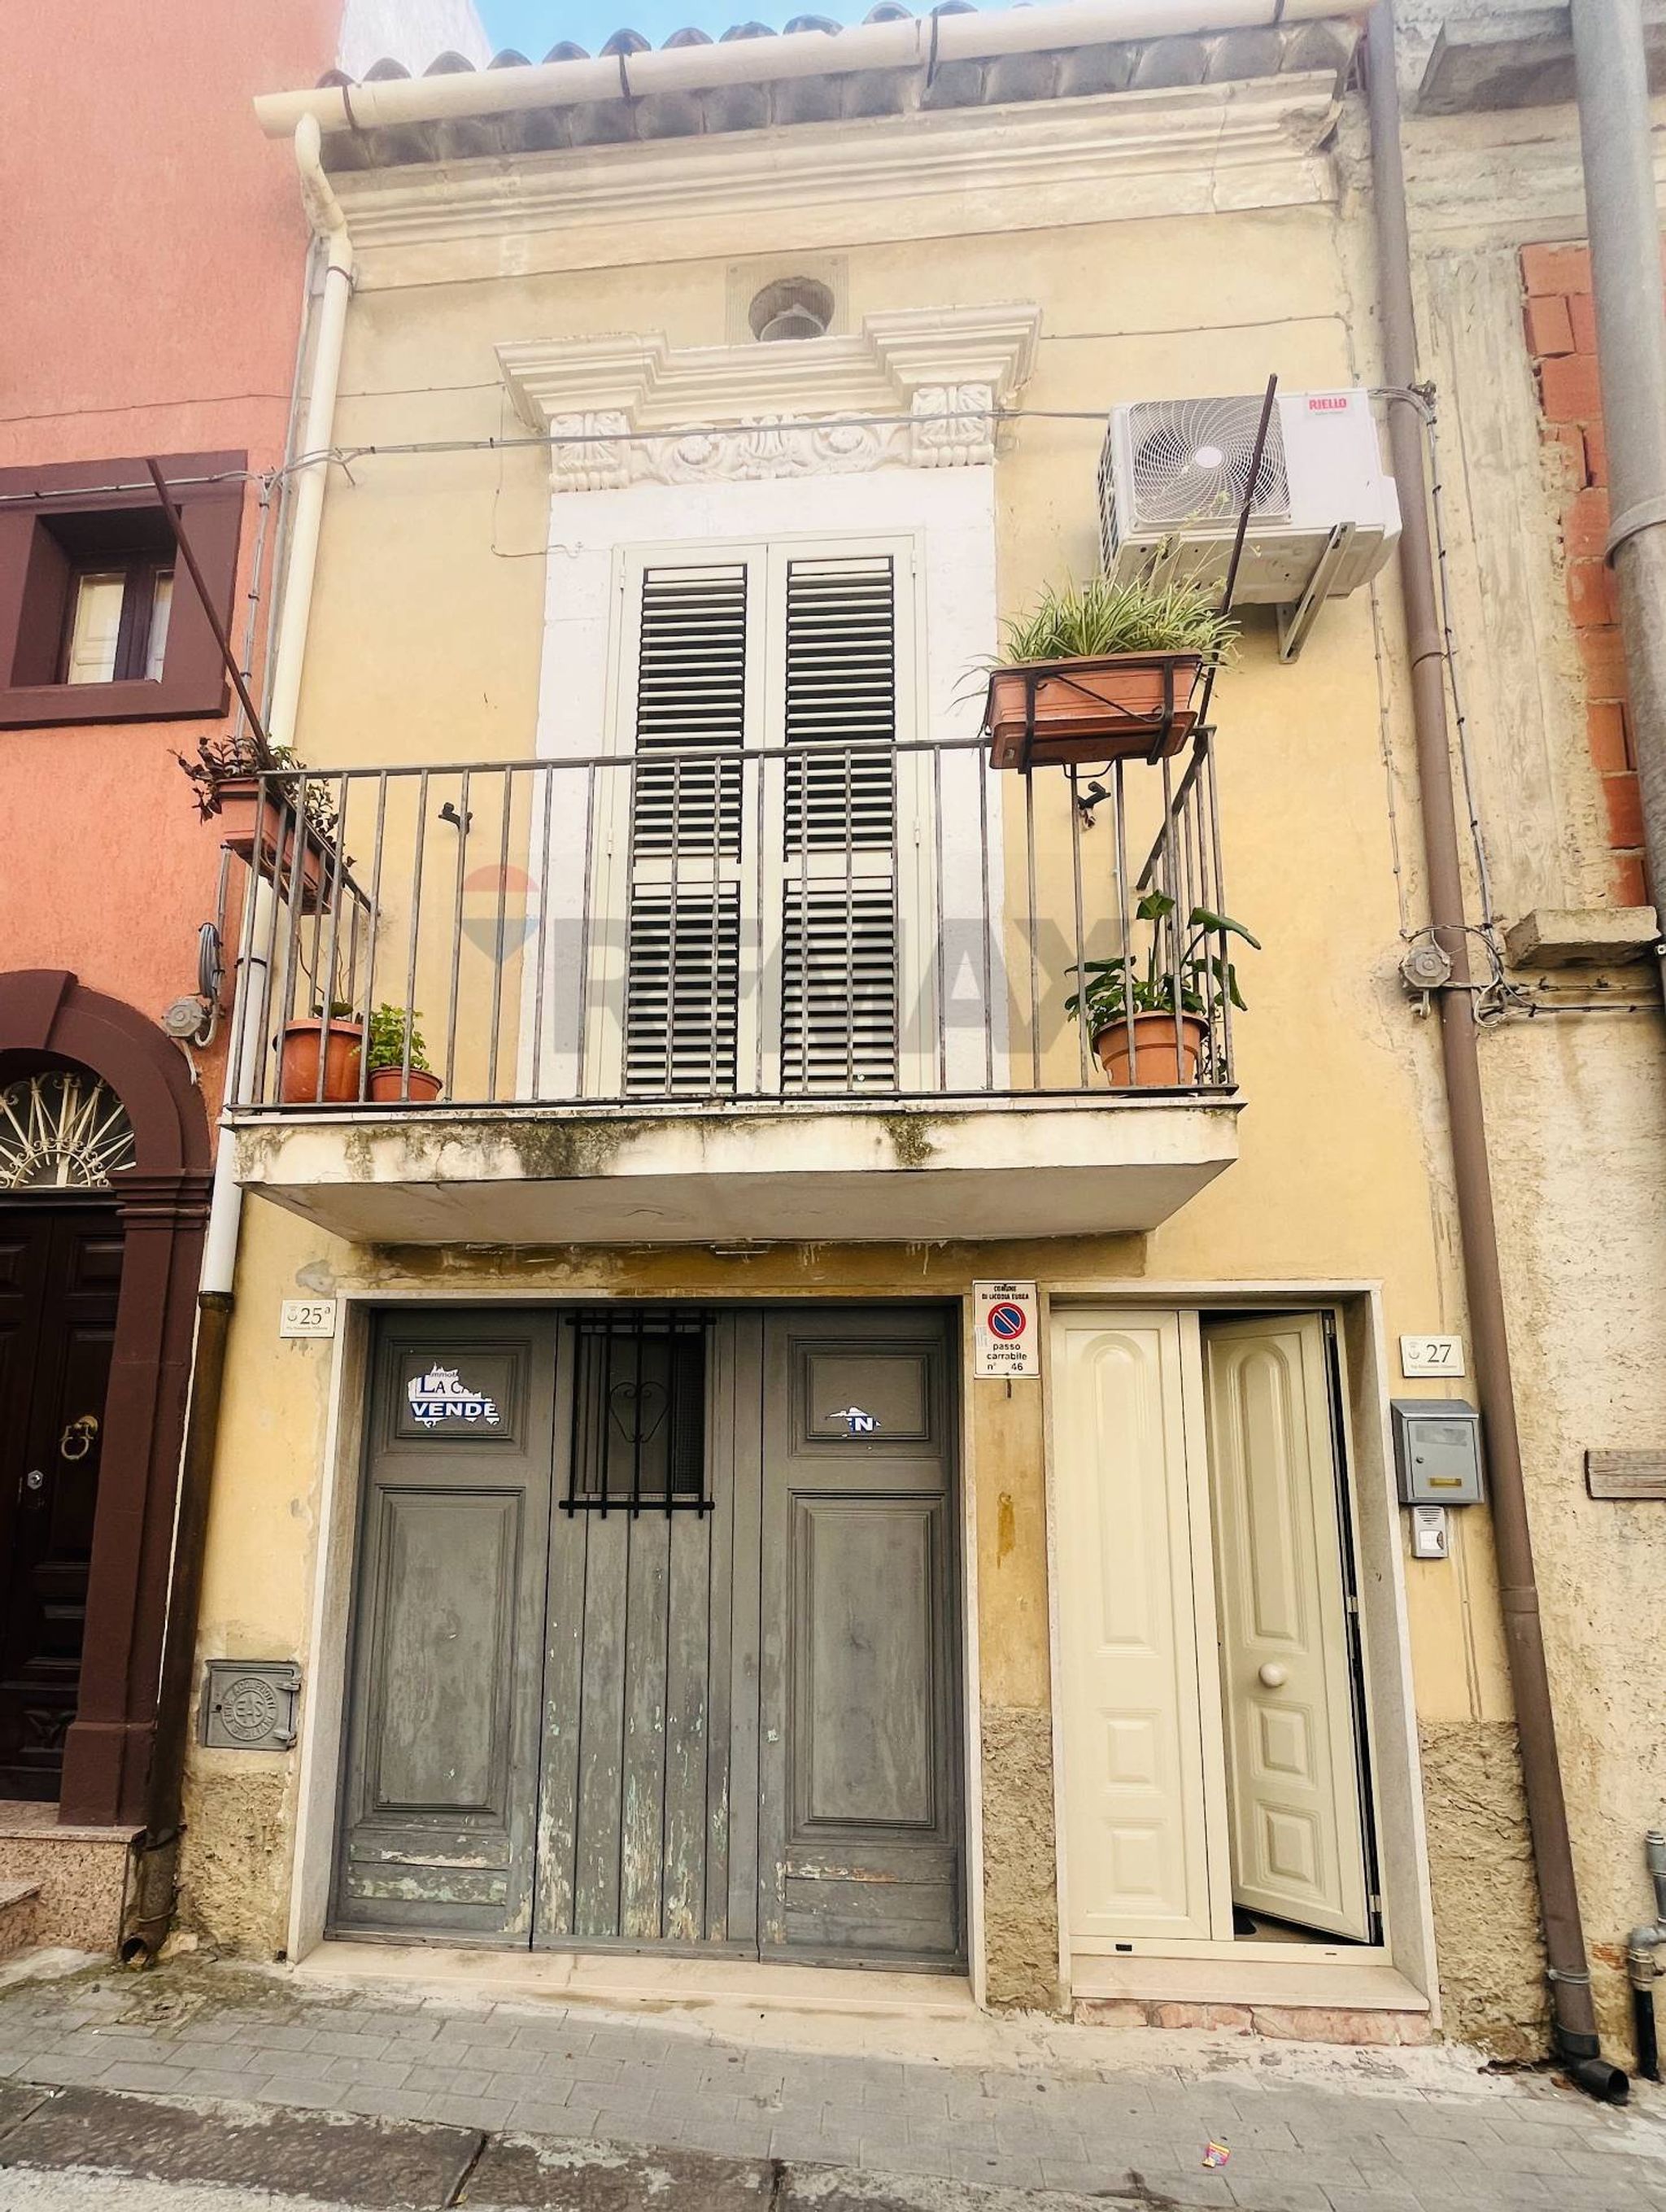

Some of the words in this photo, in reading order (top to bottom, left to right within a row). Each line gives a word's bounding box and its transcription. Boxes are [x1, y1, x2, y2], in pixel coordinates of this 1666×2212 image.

[1309, 398, 1347, 410] RIELLO
[992, 1343, 1021, 1351] passo
[987, 1352, 1027, 1360] carrabile
[1426, 1344, 1451, 1363] 27
[1011, 1363, 1023, 1371] 46
[420, 1377, 446, 1394] LA
[412, 1403, 499, 1416] VENDE
